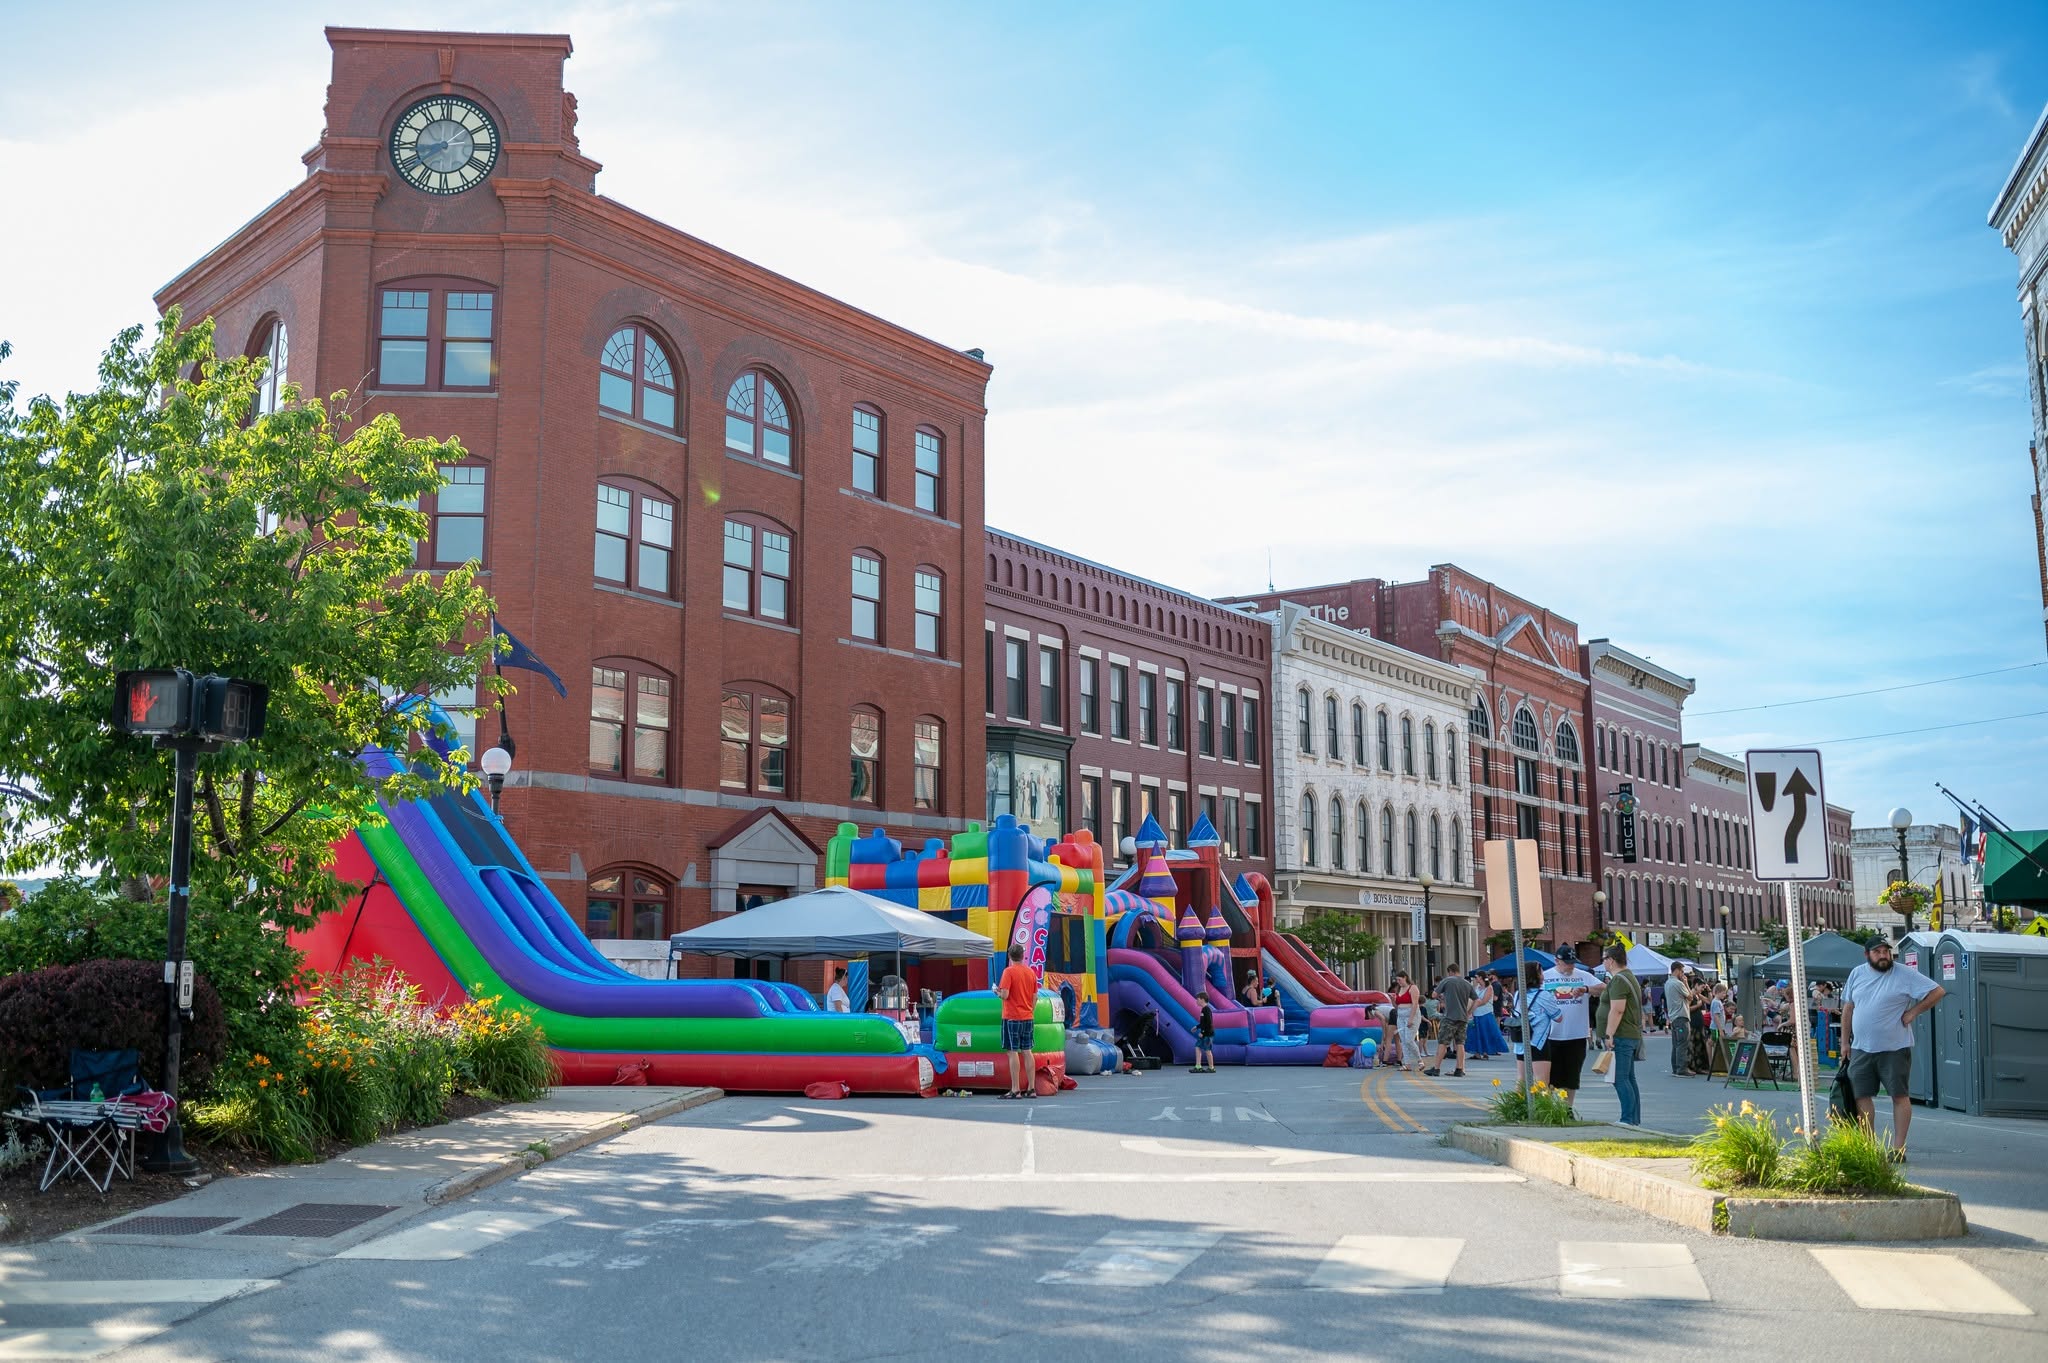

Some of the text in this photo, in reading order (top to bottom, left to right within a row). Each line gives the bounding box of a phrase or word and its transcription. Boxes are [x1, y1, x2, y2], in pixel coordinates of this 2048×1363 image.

[1309, 604, 1349, 621] The
[1623, 816, 1634, 849] HUB
[1373, 893, 1387, 904] BOYS
[1388, 893, 1393, 904] &
[1393, 894, 1408, 905] GIRLS
